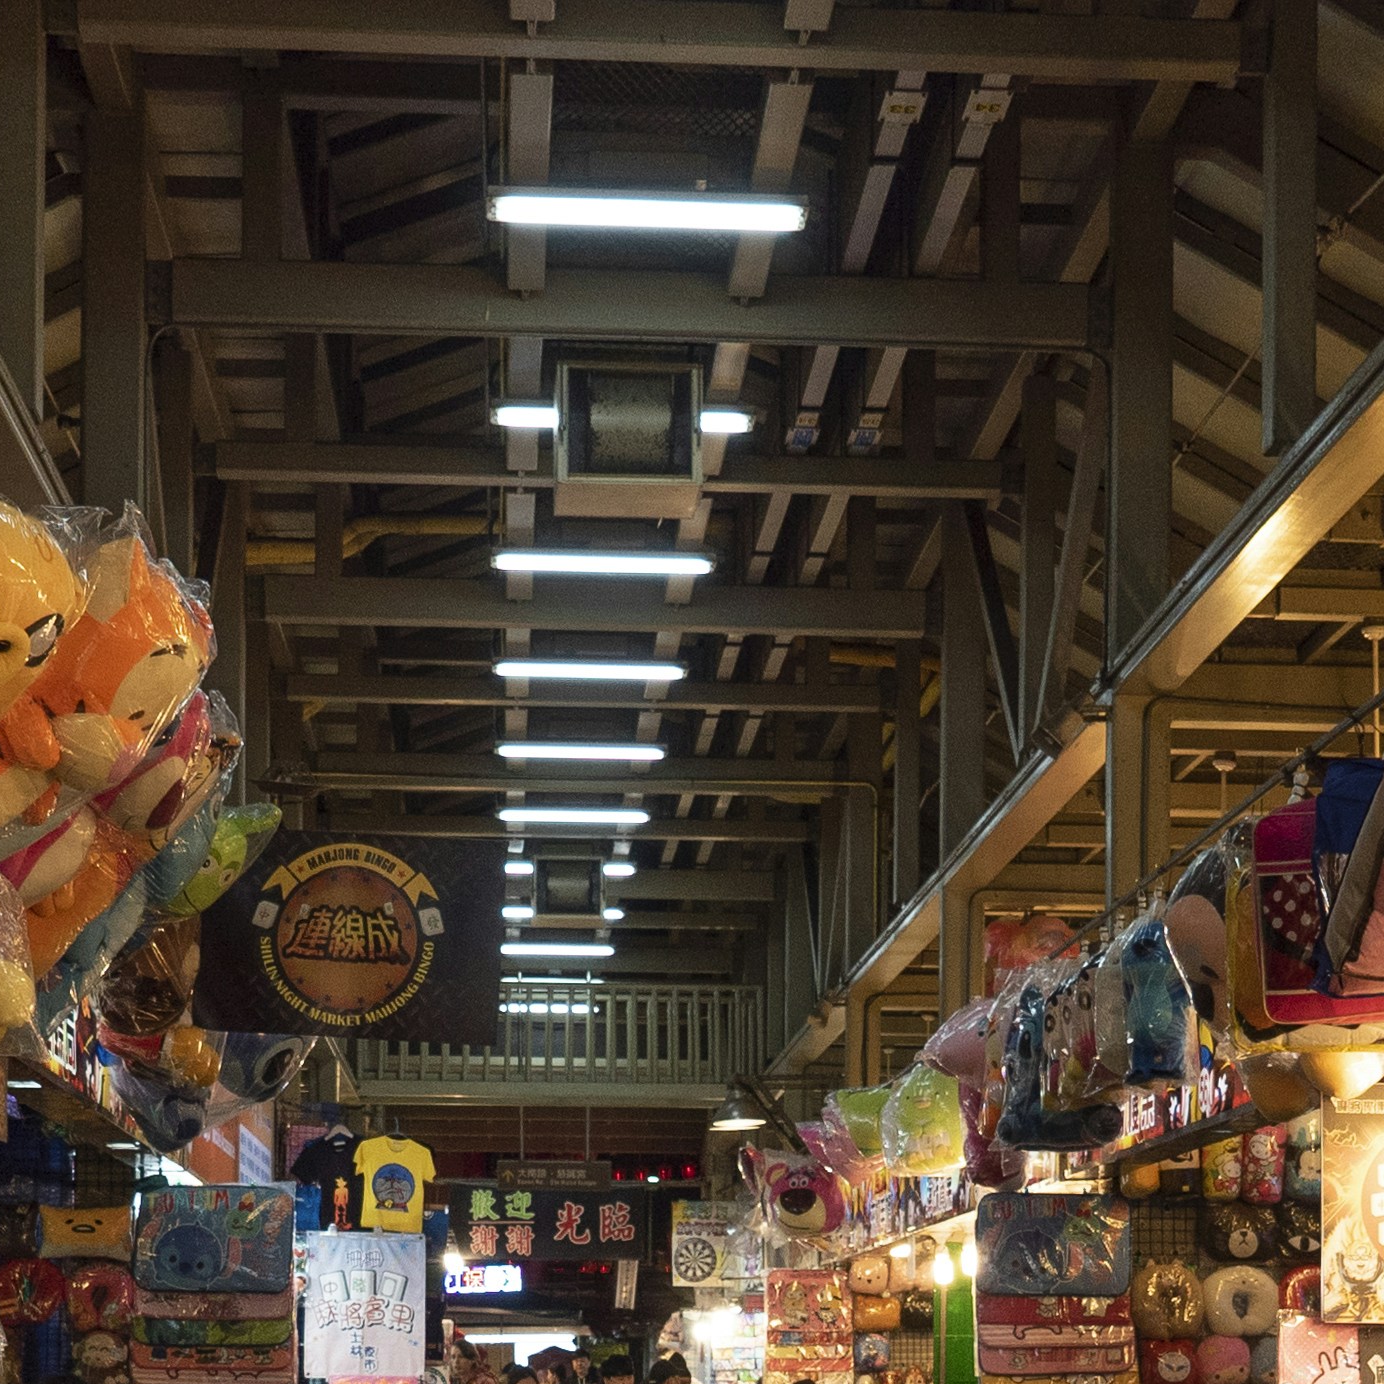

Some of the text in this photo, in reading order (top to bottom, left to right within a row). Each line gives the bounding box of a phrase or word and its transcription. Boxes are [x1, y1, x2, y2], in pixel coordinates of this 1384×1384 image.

[307, 848, 396, 874] MAHJONG BINGO
[285, 908, 406, 960] 連線成
[260, 936, 435, 1027] SHILIN NIGHT MARKET MAHJONG BINGO
[469, 1189, 535, 1221] 歡迎
[469, 1201, 636, 1257] 謝謝 光臨
